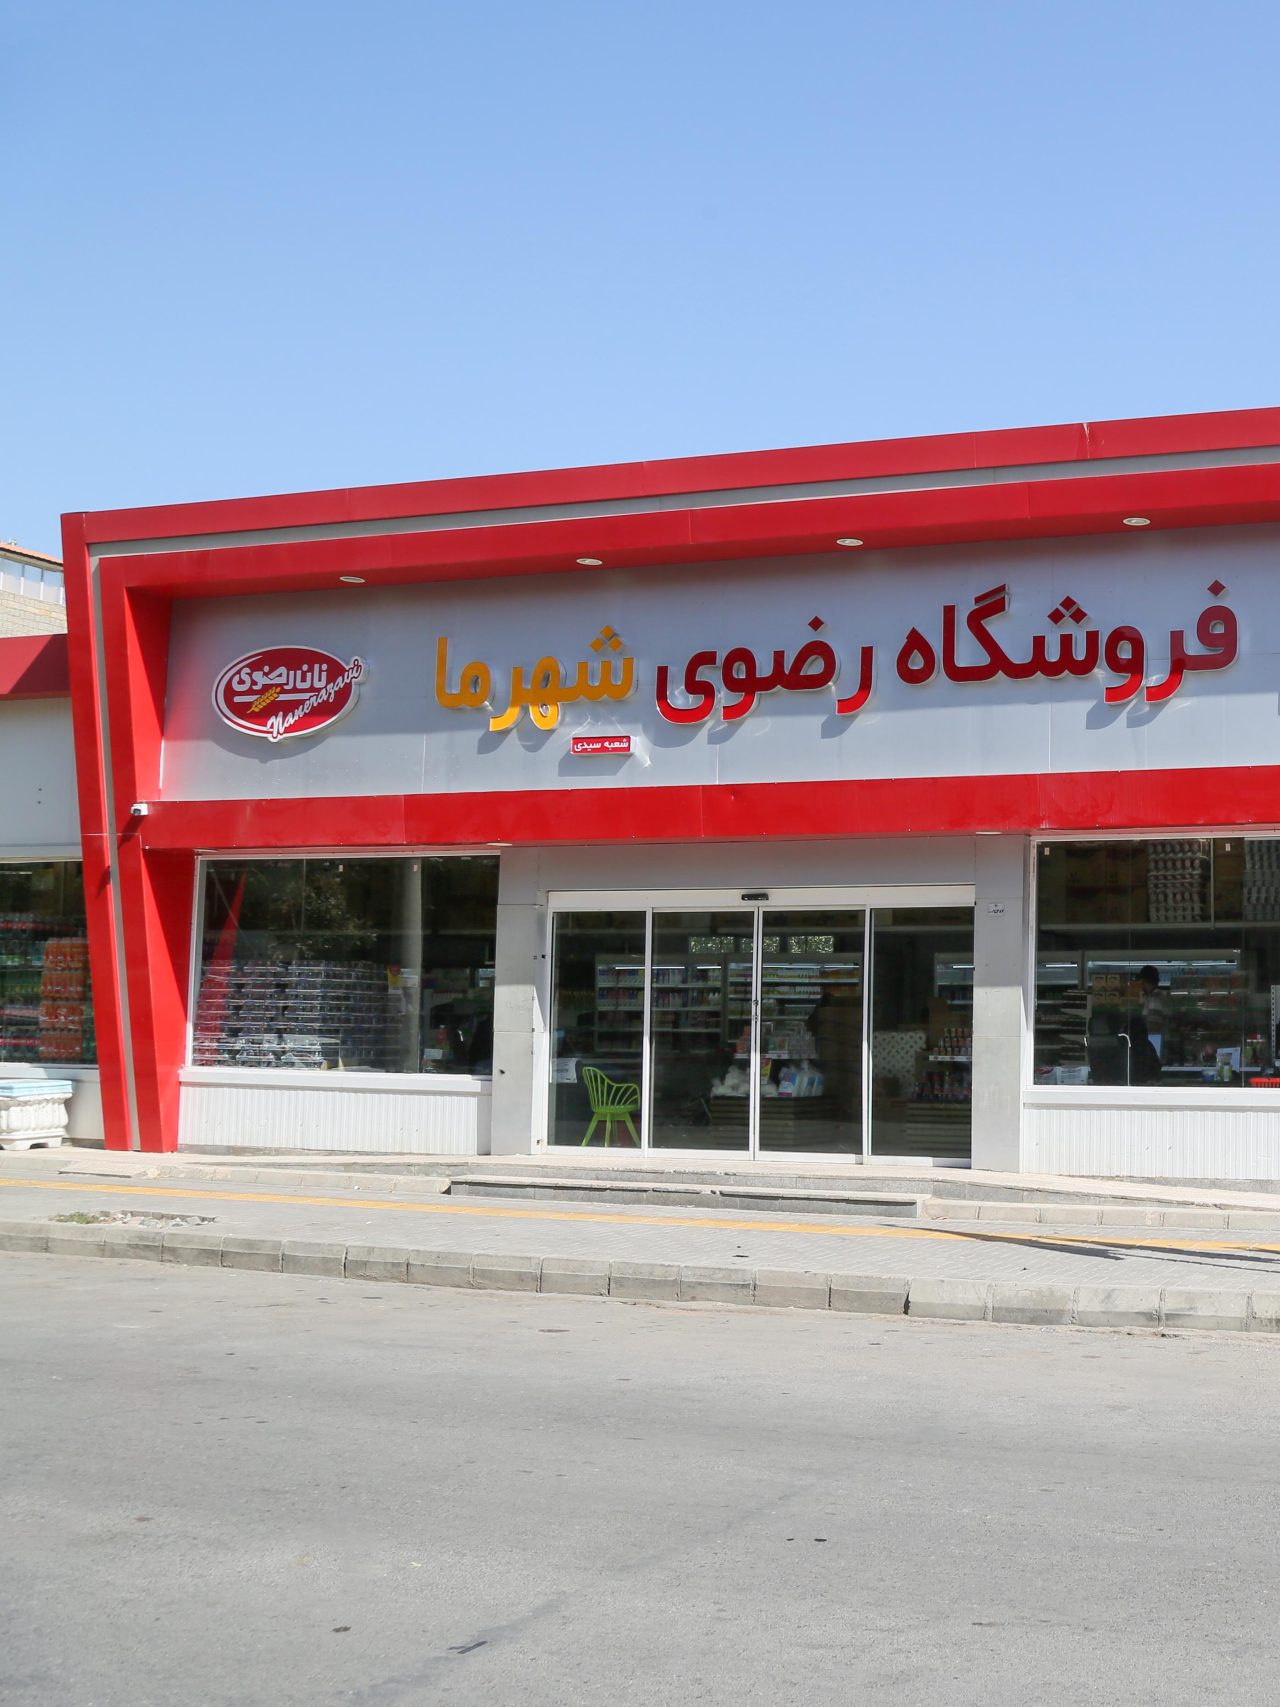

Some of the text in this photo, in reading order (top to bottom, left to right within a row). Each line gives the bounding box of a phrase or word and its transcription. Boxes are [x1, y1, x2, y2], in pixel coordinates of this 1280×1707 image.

[656, 616, 875, 725] رضوی
[896, 579, 1238, 704] فروشگاه
[267, 659, 362, 737] Nanerazavi
[574, 738, 629, 752] شعبه سیدی
